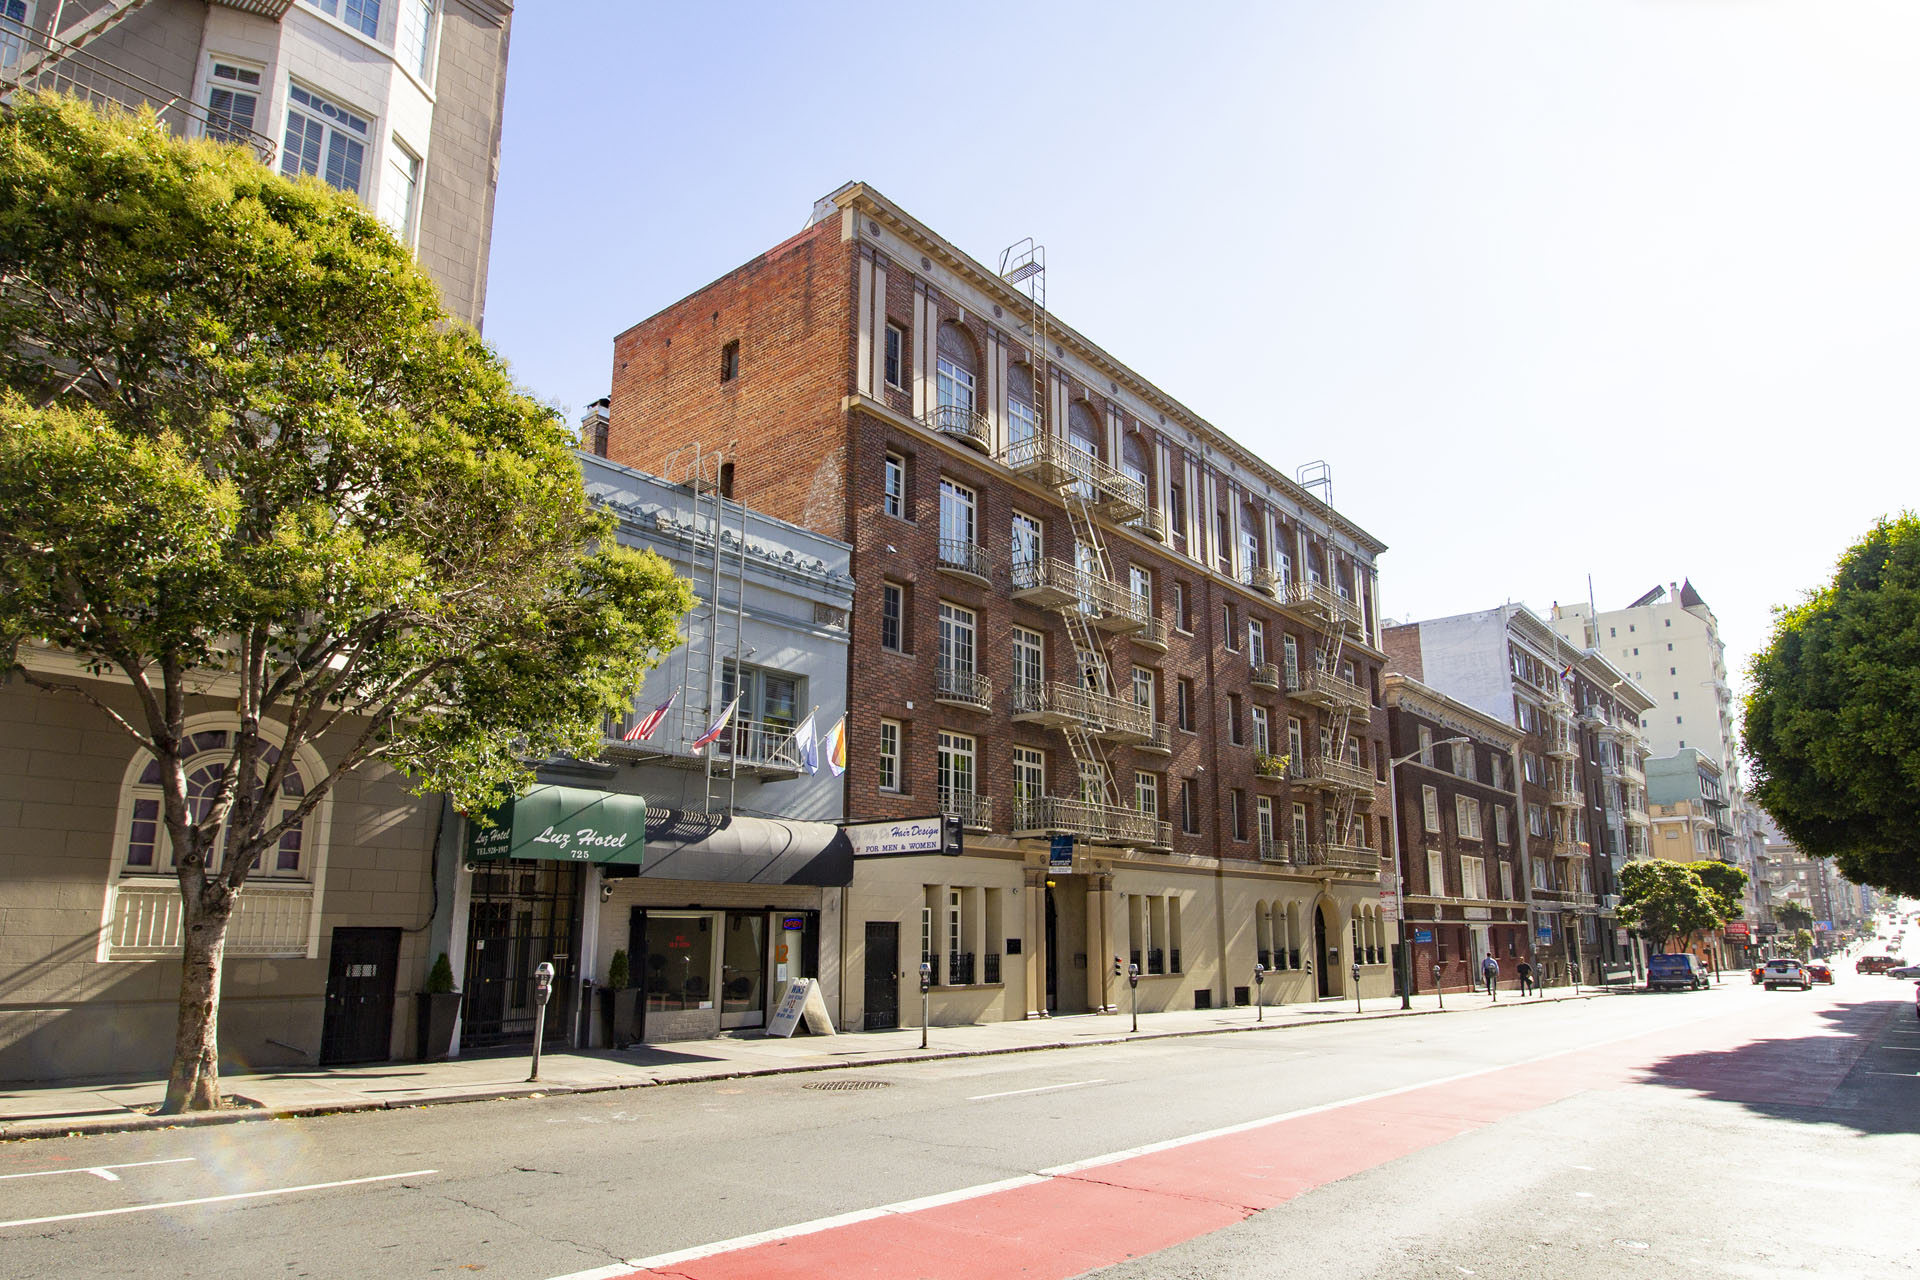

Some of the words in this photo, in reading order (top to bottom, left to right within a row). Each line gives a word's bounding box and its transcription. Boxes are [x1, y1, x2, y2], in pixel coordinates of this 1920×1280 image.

[475, 831, 488, 848] Luz
[490, 828, 511, 842] Hotel
[533, 825, 571, 849] Luz
[576, 828, 628, 848] Hotel
[890, 826, 910, 838] Hair
[911, 825, 939, 839] Design
[882, 843, 898, 851] MEN
[909, 841, 937, 849] WOMEN
[570, 850, 589, 859] 725
[775, 944, 789, 963] 12
